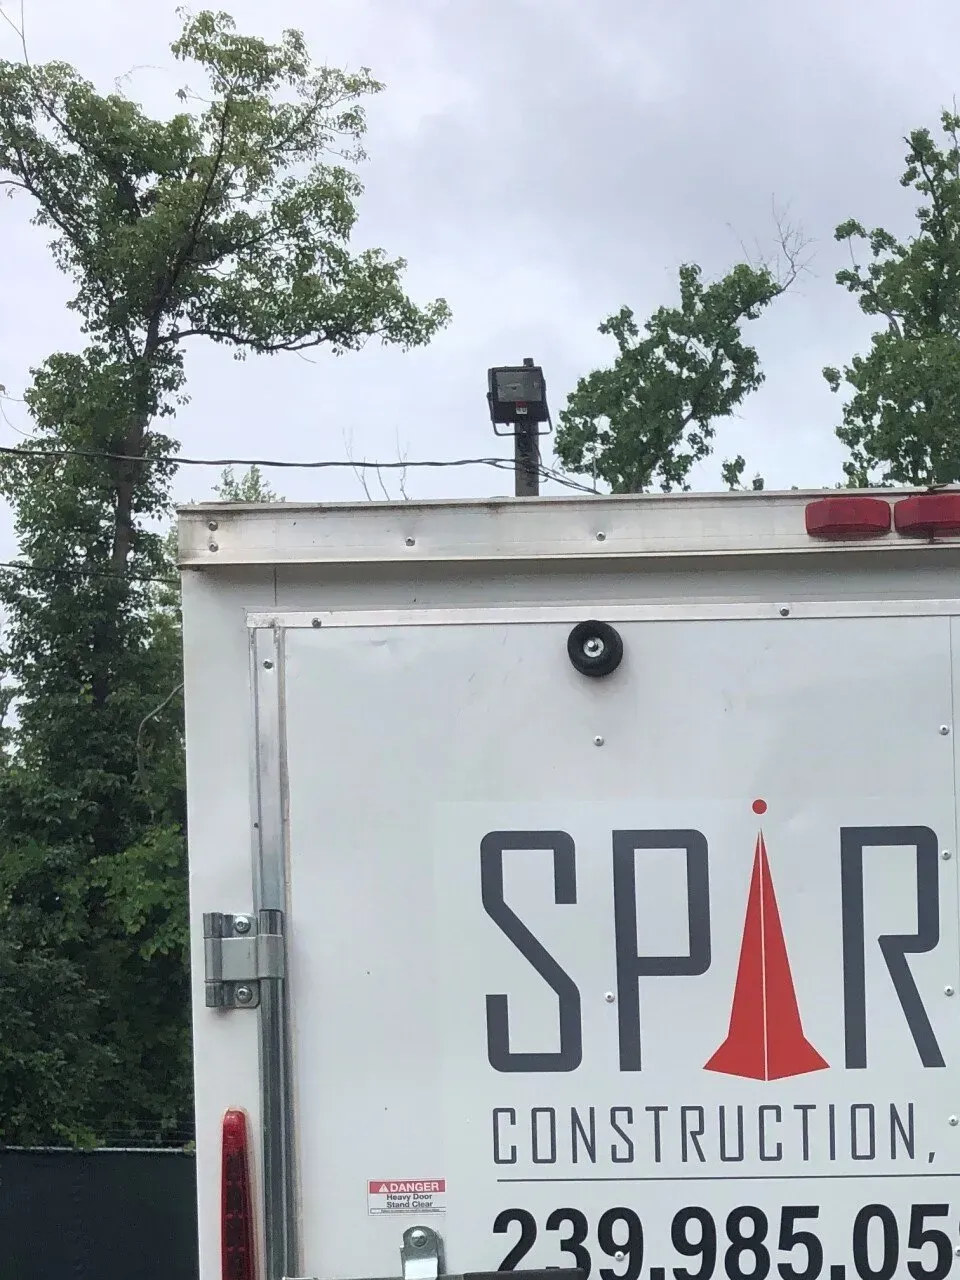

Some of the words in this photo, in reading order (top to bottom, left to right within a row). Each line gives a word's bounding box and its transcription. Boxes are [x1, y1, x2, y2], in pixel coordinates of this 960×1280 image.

[493, 1103, 935, 1164] CONSTRUCTION,
[390, 1182, 439, 1192] DANGER
[386, 1193, 411, 1202] Heavy
